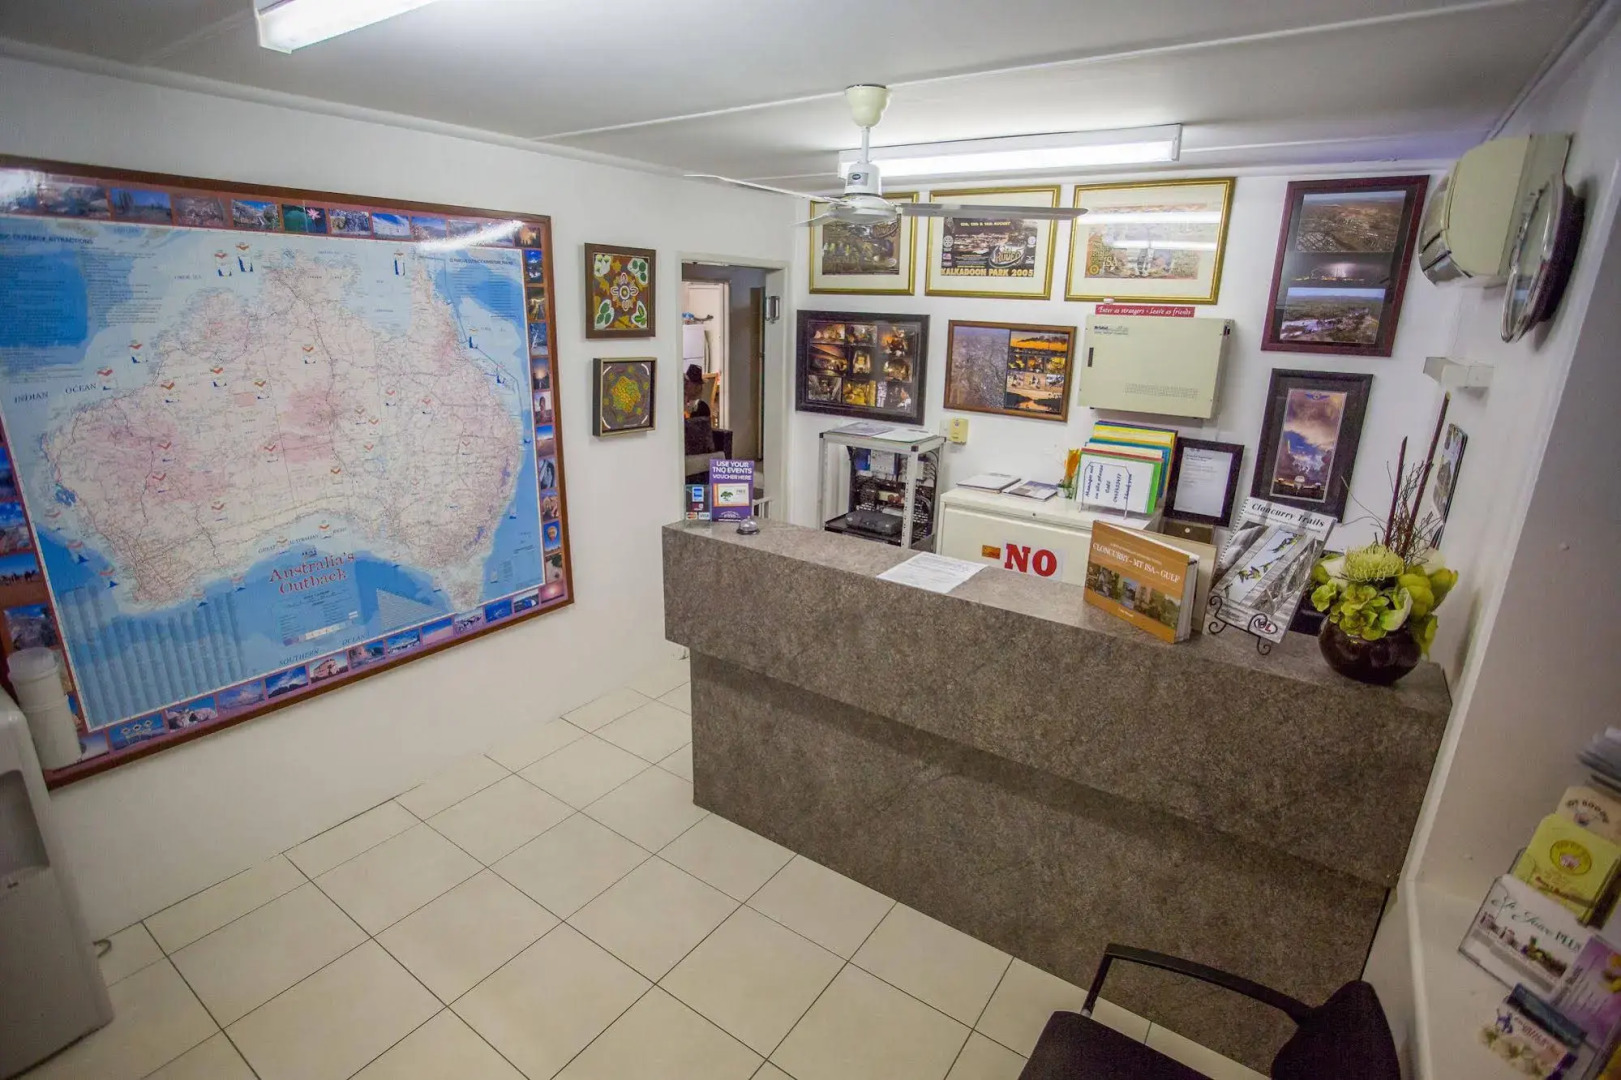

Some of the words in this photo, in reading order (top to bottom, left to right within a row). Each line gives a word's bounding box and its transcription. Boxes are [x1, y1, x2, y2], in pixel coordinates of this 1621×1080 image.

[49, 234, 94, 245] ATTRACTIONS
[941, 267, 987, 276] KALKADOON
[988, 268, 1009, 277] PARK
[1011, 268, 1034, 277] 2005
[1098, 305, 1113, 313] Enter
[1120, 307, 1145, 316] strangers
[1172, 307, 1191, 317] friends
[14, 391, 49, 404] INDIAN
[64, 383, 97, 395] OCEAN
[1251, 503, 1295, 520] Cloncurry
[1298, 515, 1325, 527] Trails
[269, 551, 355, 583] Australia's
[1004, 543, 1057, 577] NO
[1092, 543, 1129, 563] CLONCURRY
[1133, 558, 1145, 569] MT
[1144, 560, 1156, 574] ISA
[1160, 569, 1180, 583] GULF
[279, 568, 347, 594] Outback
[279, 649, 320, 666] SOUTHERN
